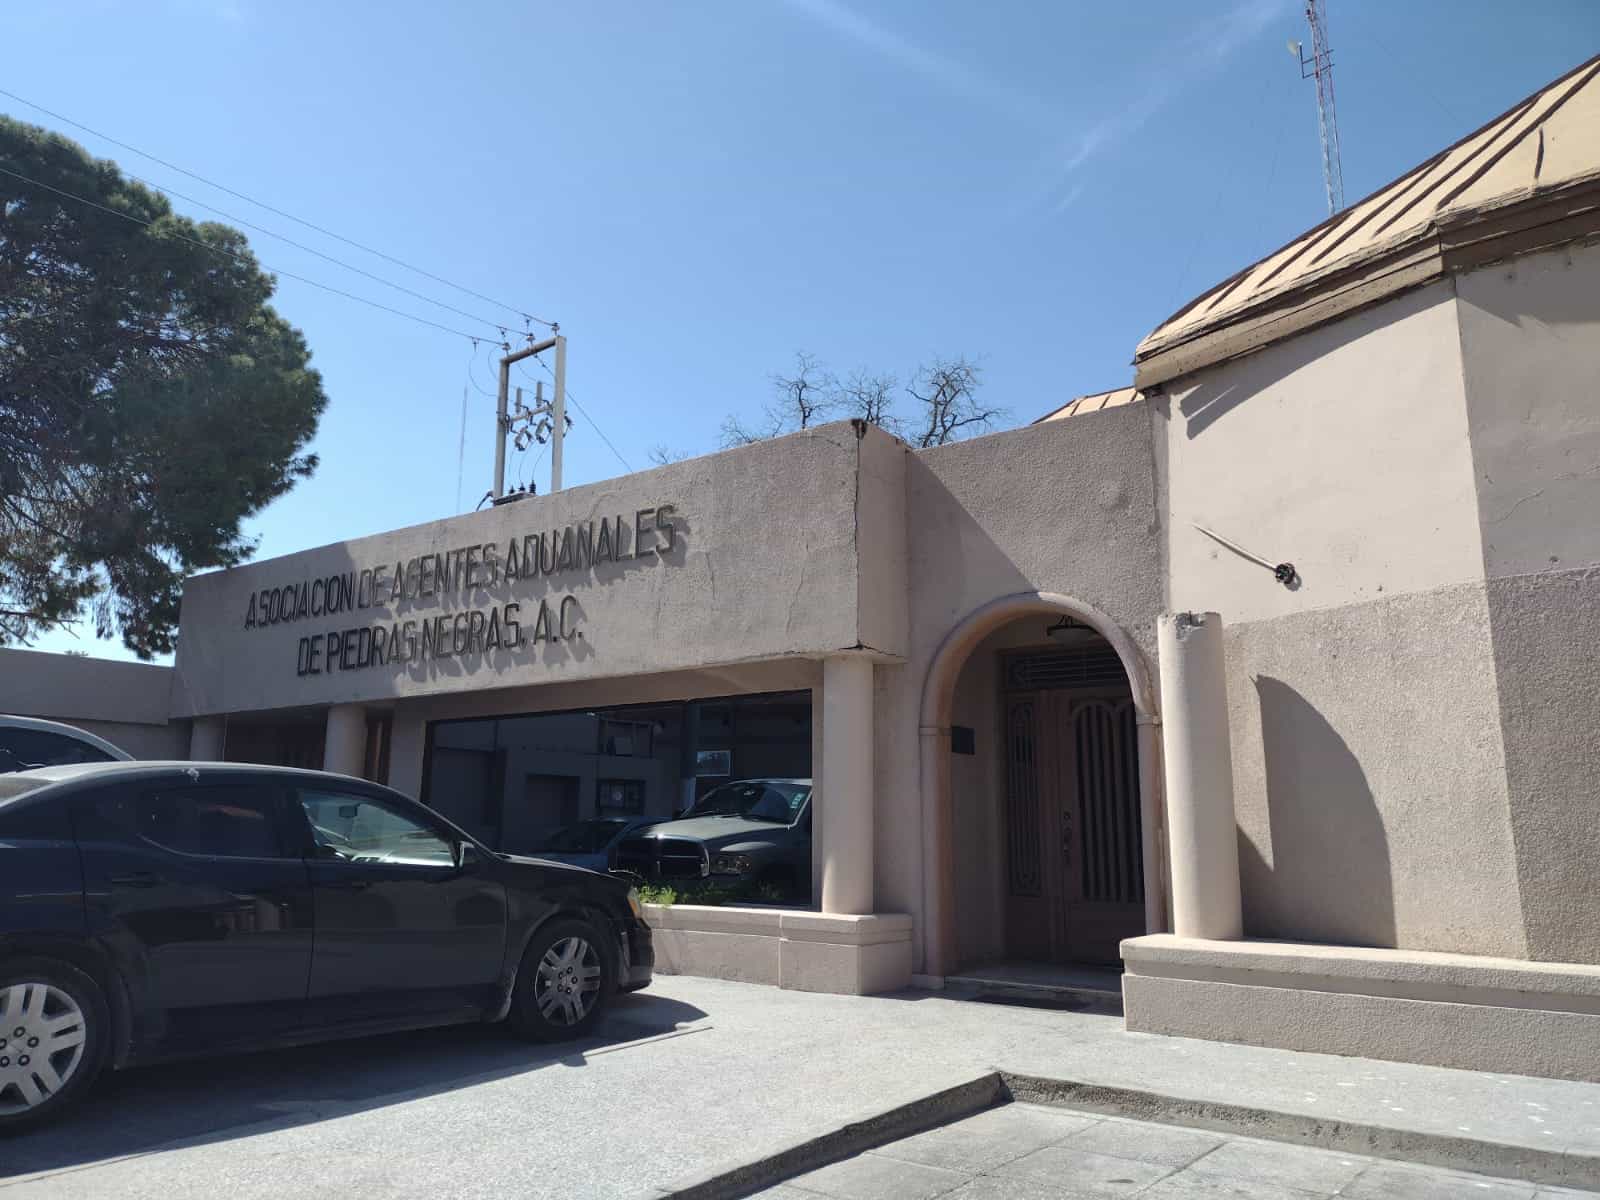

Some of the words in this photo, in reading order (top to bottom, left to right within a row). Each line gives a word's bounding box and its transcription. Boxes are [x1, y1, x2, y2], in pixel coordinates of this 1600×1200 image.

[245, 572, 354, 631] ASOCIACION
[358, 565, 386, 609] DE
[391, 542, 498, 602] AGENTES
[504, 505, 677, 584] ADUANALES
[297, 633, 326, 676] DE
[326, 622, 416, 674] PIEDRAS
[533, 595, 584, 644] A.C.
